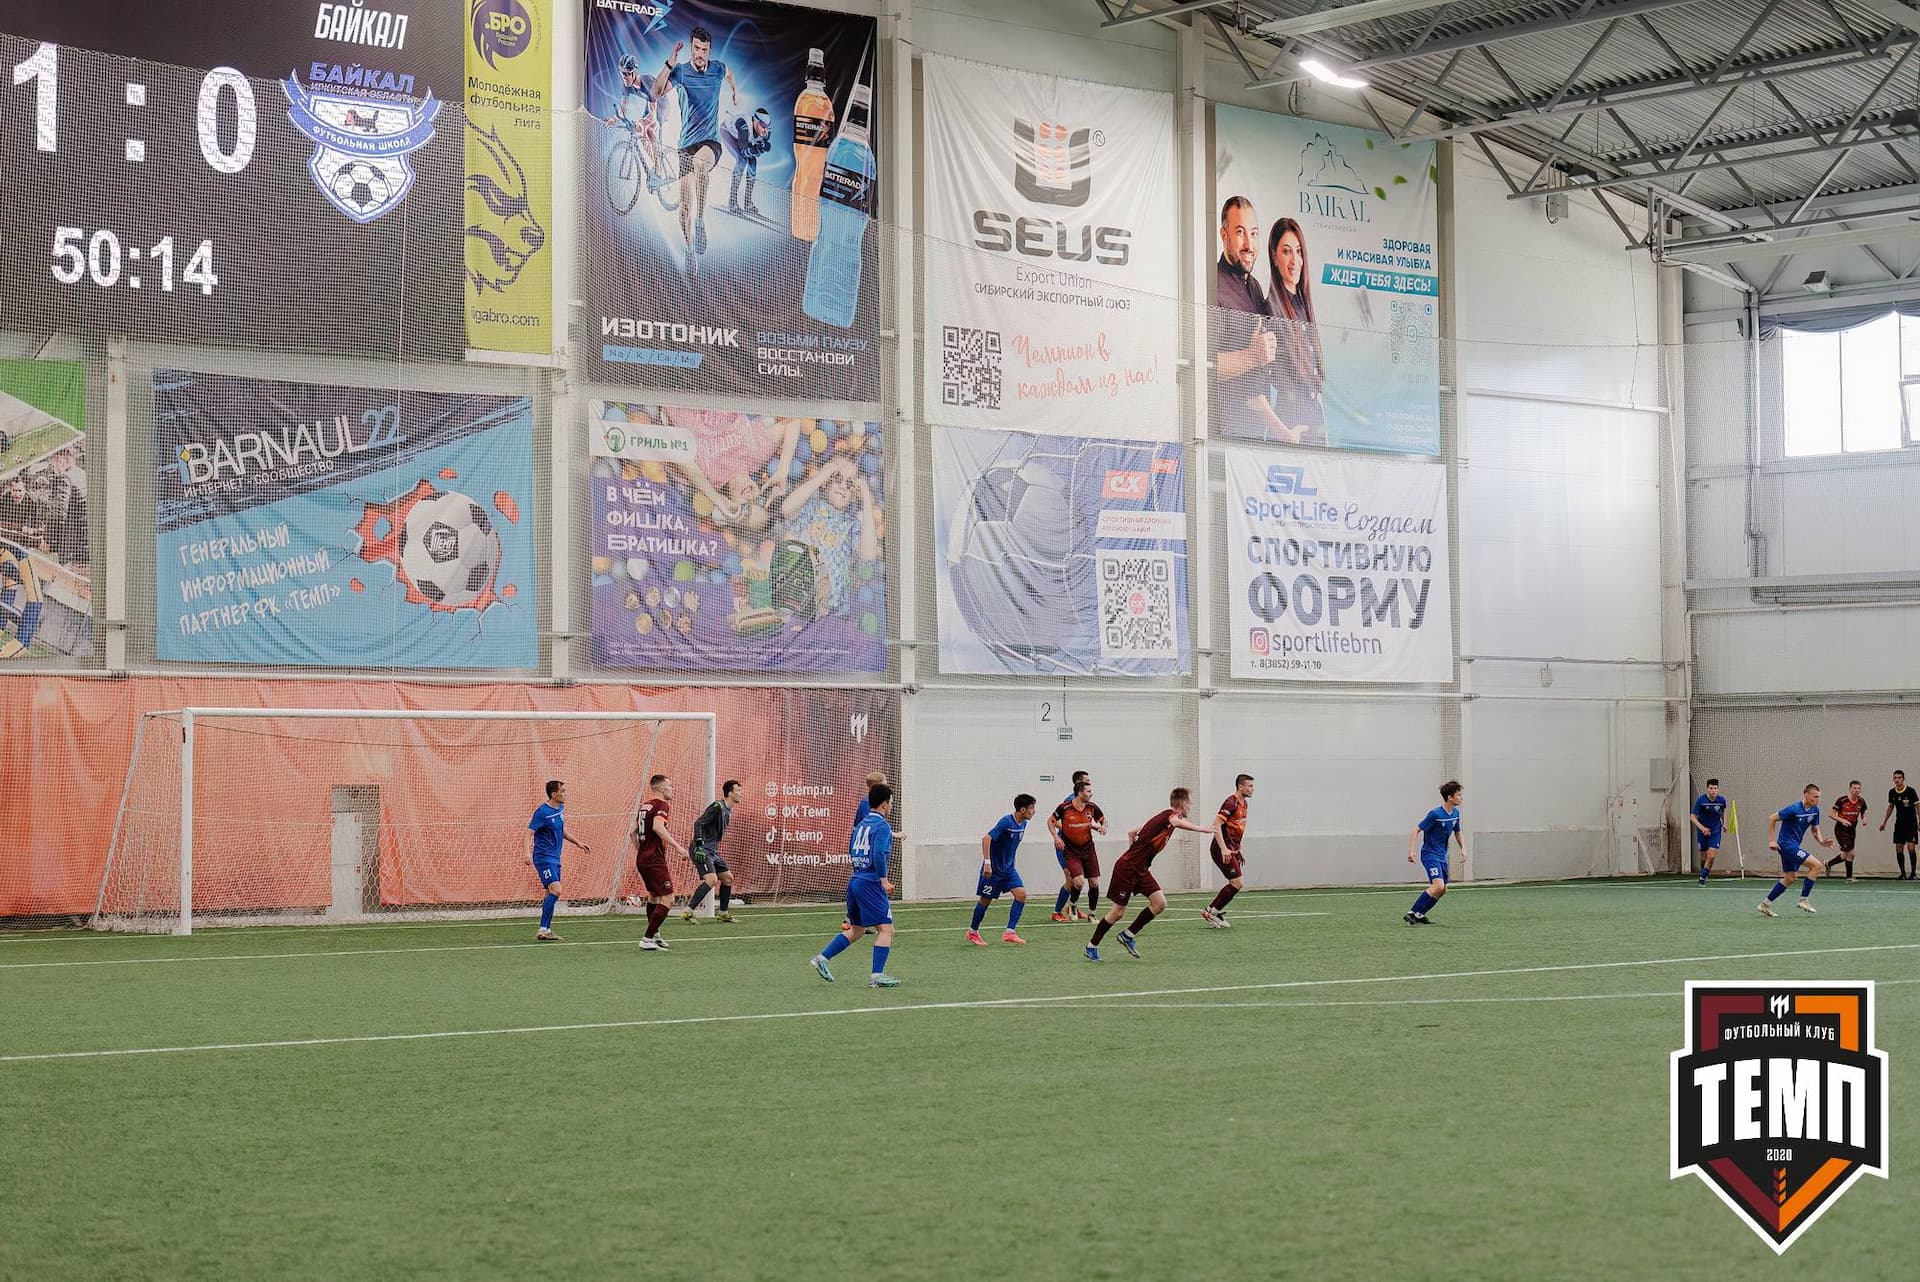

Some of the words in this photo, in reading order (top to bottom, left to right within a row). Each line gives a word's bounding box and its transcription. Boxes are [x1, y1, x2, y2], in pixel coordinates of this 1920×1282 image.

[314, 0, 408, 50] БАЙКАЛ
[309, 61, 415, 94] БАЙКАЛ
[468, 76, 541, 100] Молодёжная
[13, 42, 58, 153] 1
[196, 66, 257, 174] 0
[470, 92, 541, 114] футбольная
[514, 118, 541, 130] лига
[312, 126, 375, 150] ФУТБОЛЬНАЯ
[379, 137, 411, 150] ШКОЛА
[1300, 191, 1370, 223] BAIKAL
[973, 209, 1132, 266] SEUS
[1383, 239, 1431, 254] ЗДОРОВАЯ
[51, 225, 219, 295] 50:14
[1337, 248, 1344, 259] И
[1346, 250, 1394, 266] КРАСИВАЯ
[1396, 256, 1431, 270] УЛЫБКА
[1016, 266, 1055, 286] Export
[1059, 271, 1092, 289] Union
[1330, 268, 1363, 285] ЖДЕТ
[1365, 272, 1391, 288] ТЕБЯ
[1393, 276, 1431, 292] ЗДЕСЬ!
[975, 282, 1034, 300] СИБИРСКИЙ
[1038, 292, 1103, 308] ЭКСПОРТНЫЙ
[602, 316, 739, 347] ИЗОТОНИК
[758, 331, 818, 347] ВОЗЬМИ
[758, 347, 855, 366] ВОССТАНОВИ
[1012, 334, 1094, 368] Чемпион
[1018, 367, 1094, 399] каждом
[1098, 373, 1117, 398] из
[631, 436, 667, 449] ГРИЛЬ
[184, 476, 244, 498] ИНТЕРНЕТ
[254, 459, 334, 486] СООБЩЕСТВО
[607, 486, 618, 502] В
[623, 481, 665, 506] ЧЁМ
[1245, 496, 1338, 522] SportLife
[1344, 500, 1436, 541] Создаем
[607, 510, 689, 535] ФИШКА,
[178, 521, 290, 567] ГЕНЕРАЛЬНЫЙ
[607, 534, 718, 557] БРАТИШКА?
[1247, 535, 1432, 573] СПОРТИВНУЮ
[180, 547, 330, 603] ИНФОРМАЦИОННЫЙ
[179, 602, 250, 636] ПАРТНЕР
[254, 595, 281, 619] ФК
[285, 583, 341, 611] «ТЕМП»
[1248, 571, 1431, 630] ФОРМУ
[1272, 630, 1382, 657] sportlifebrn
[1041, 702, 1051, 722] 2
[782, 783, 833, 798] fctemp.ru
[781, 805, 799, 818] ФК
[801, 805, 830, 818] Темп
[783, 830, 823, 844] fc.temp
[852, 825, 871, 856] 44
[543, 868, 552, 879] 21
[982, 884, 993, 895] 22
